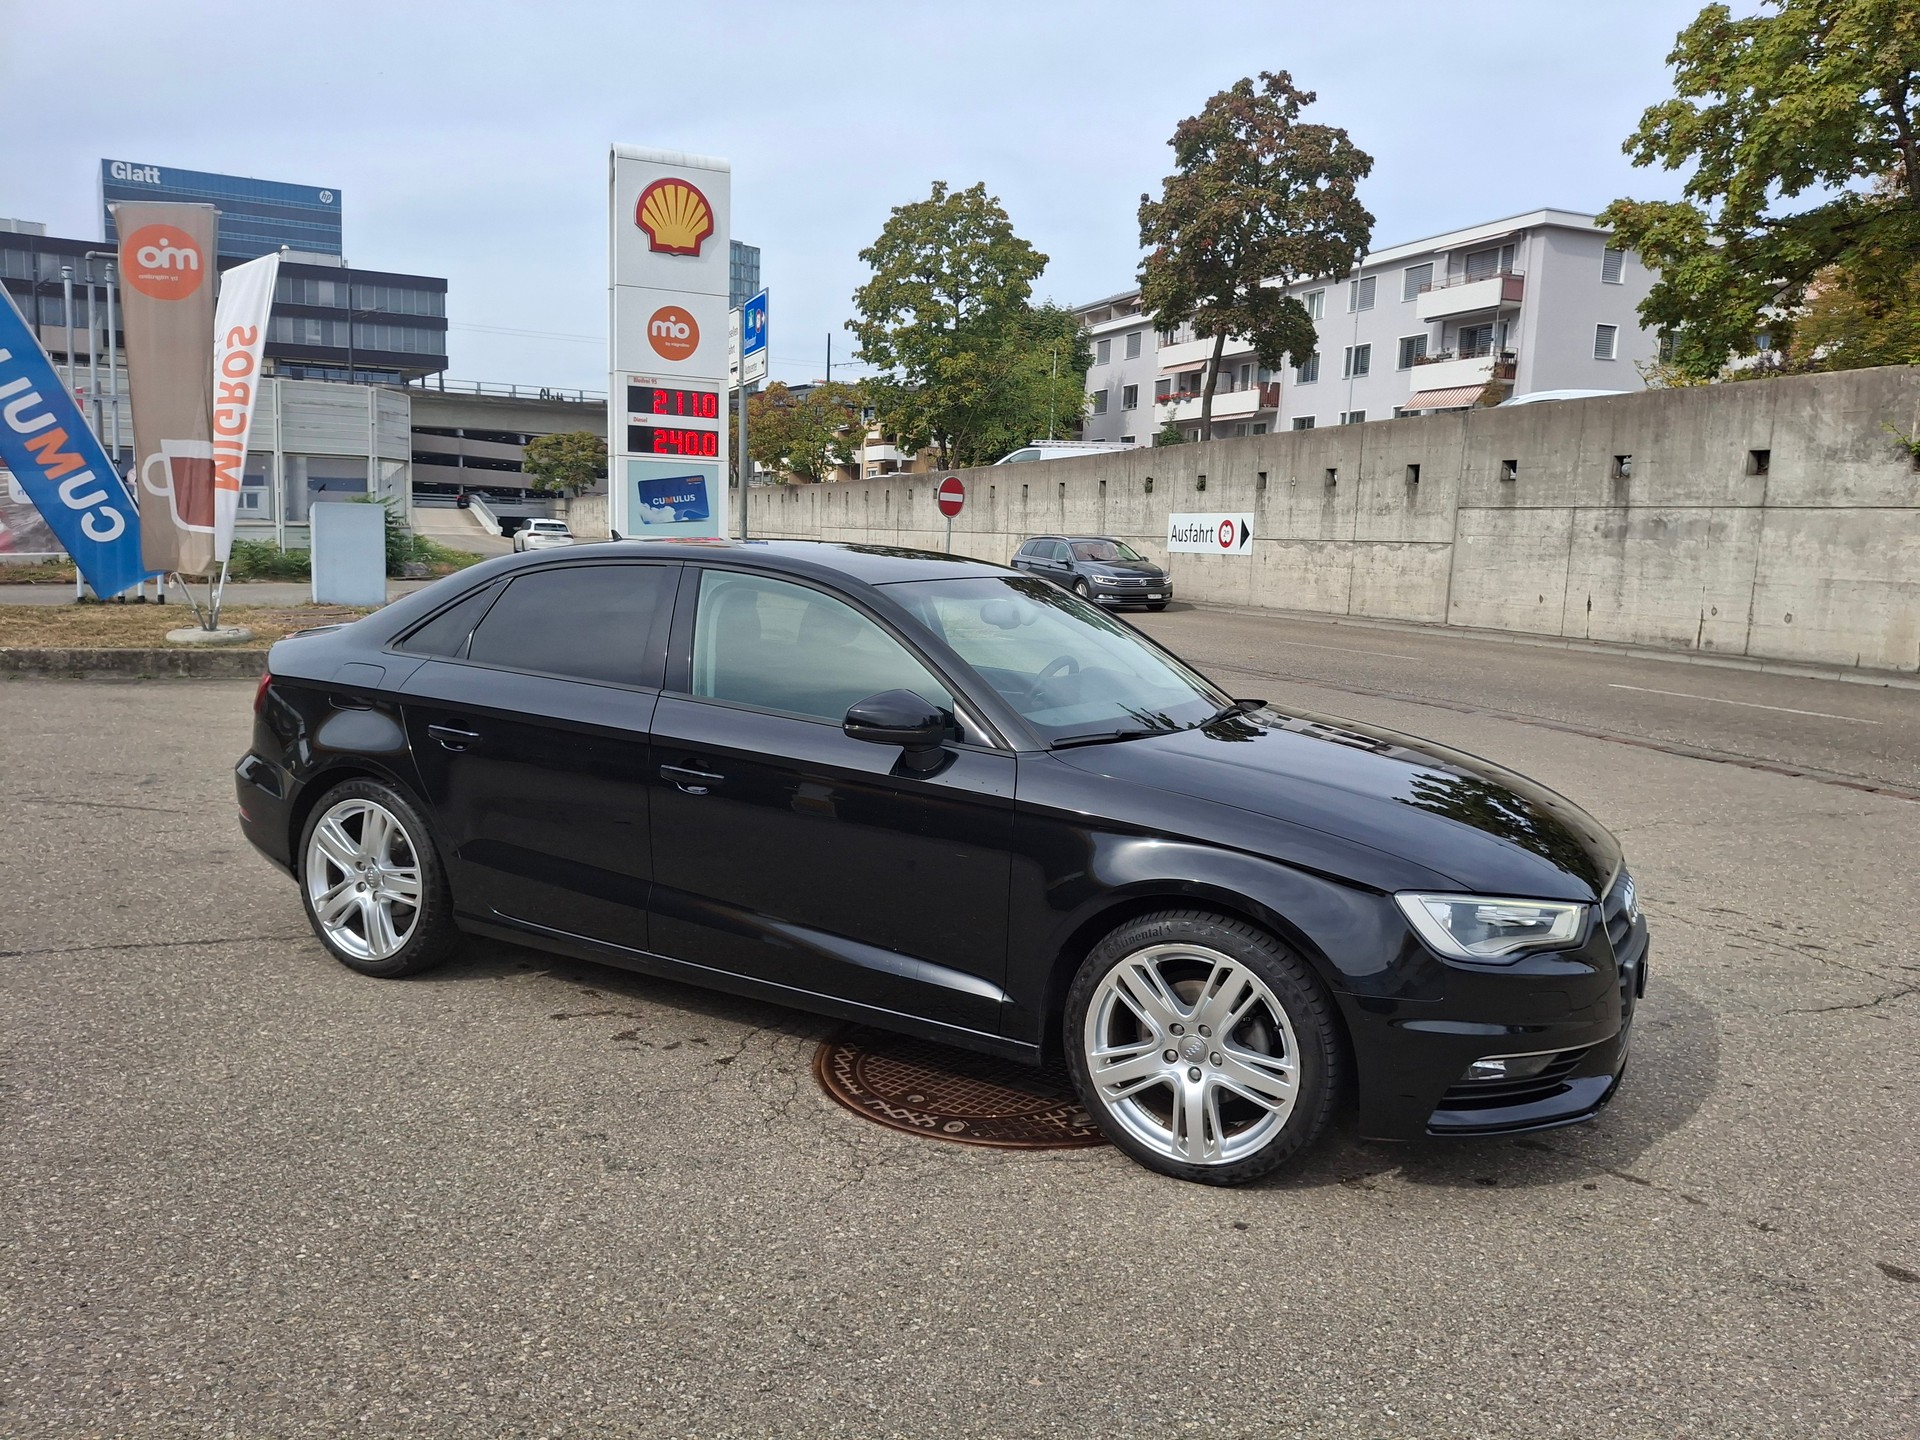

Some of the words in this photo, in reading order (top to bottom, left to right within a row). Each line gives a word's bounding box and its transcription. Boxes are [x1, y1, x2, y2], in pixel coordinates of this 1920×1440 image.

[110, 161, 161, 184] Glatt
[320, 190, 333, 204] hp
[652, 315, 690, 339] mio
[653, 389, 717, 418] 211.0
[653, 429, 716, 456] 240.0
[652, 494, 696, 505] CUMULUS
[1171, 523, 1214, 543] Ausfahrt
